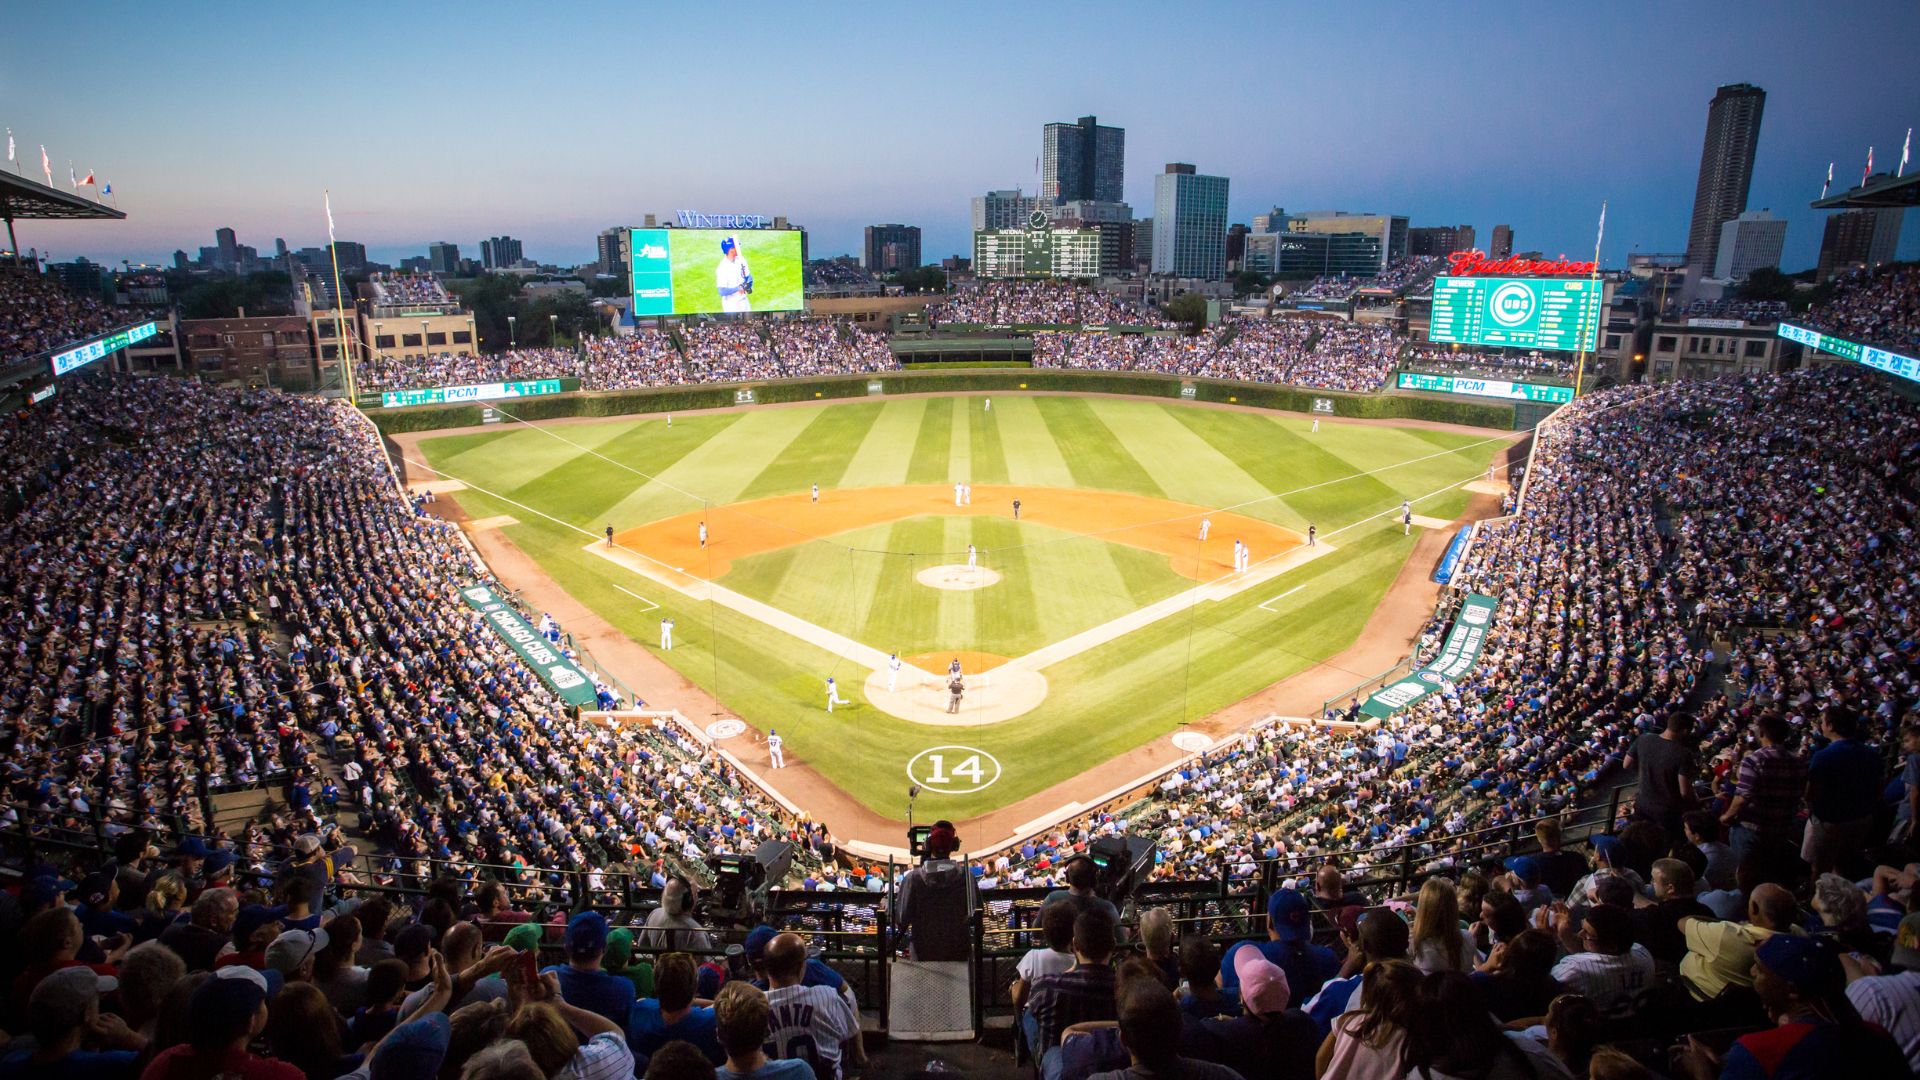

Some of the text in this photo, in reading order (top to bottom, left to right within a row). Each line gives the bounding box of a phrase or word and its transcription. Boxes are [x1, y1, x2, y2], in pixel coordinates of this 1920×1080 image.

[677, 210, 764, 229] WINTRUST
[1447, 251, 1600, 276] Budweiser
[447, 387, 478, 398] PCM
[1455, 379, 1486, 391] PCM
[490, 610, 557, 665] CHICAGO CUBS
[925, 755, 984, 784] 14
[767, 1003, 813, 1033] ANTO
